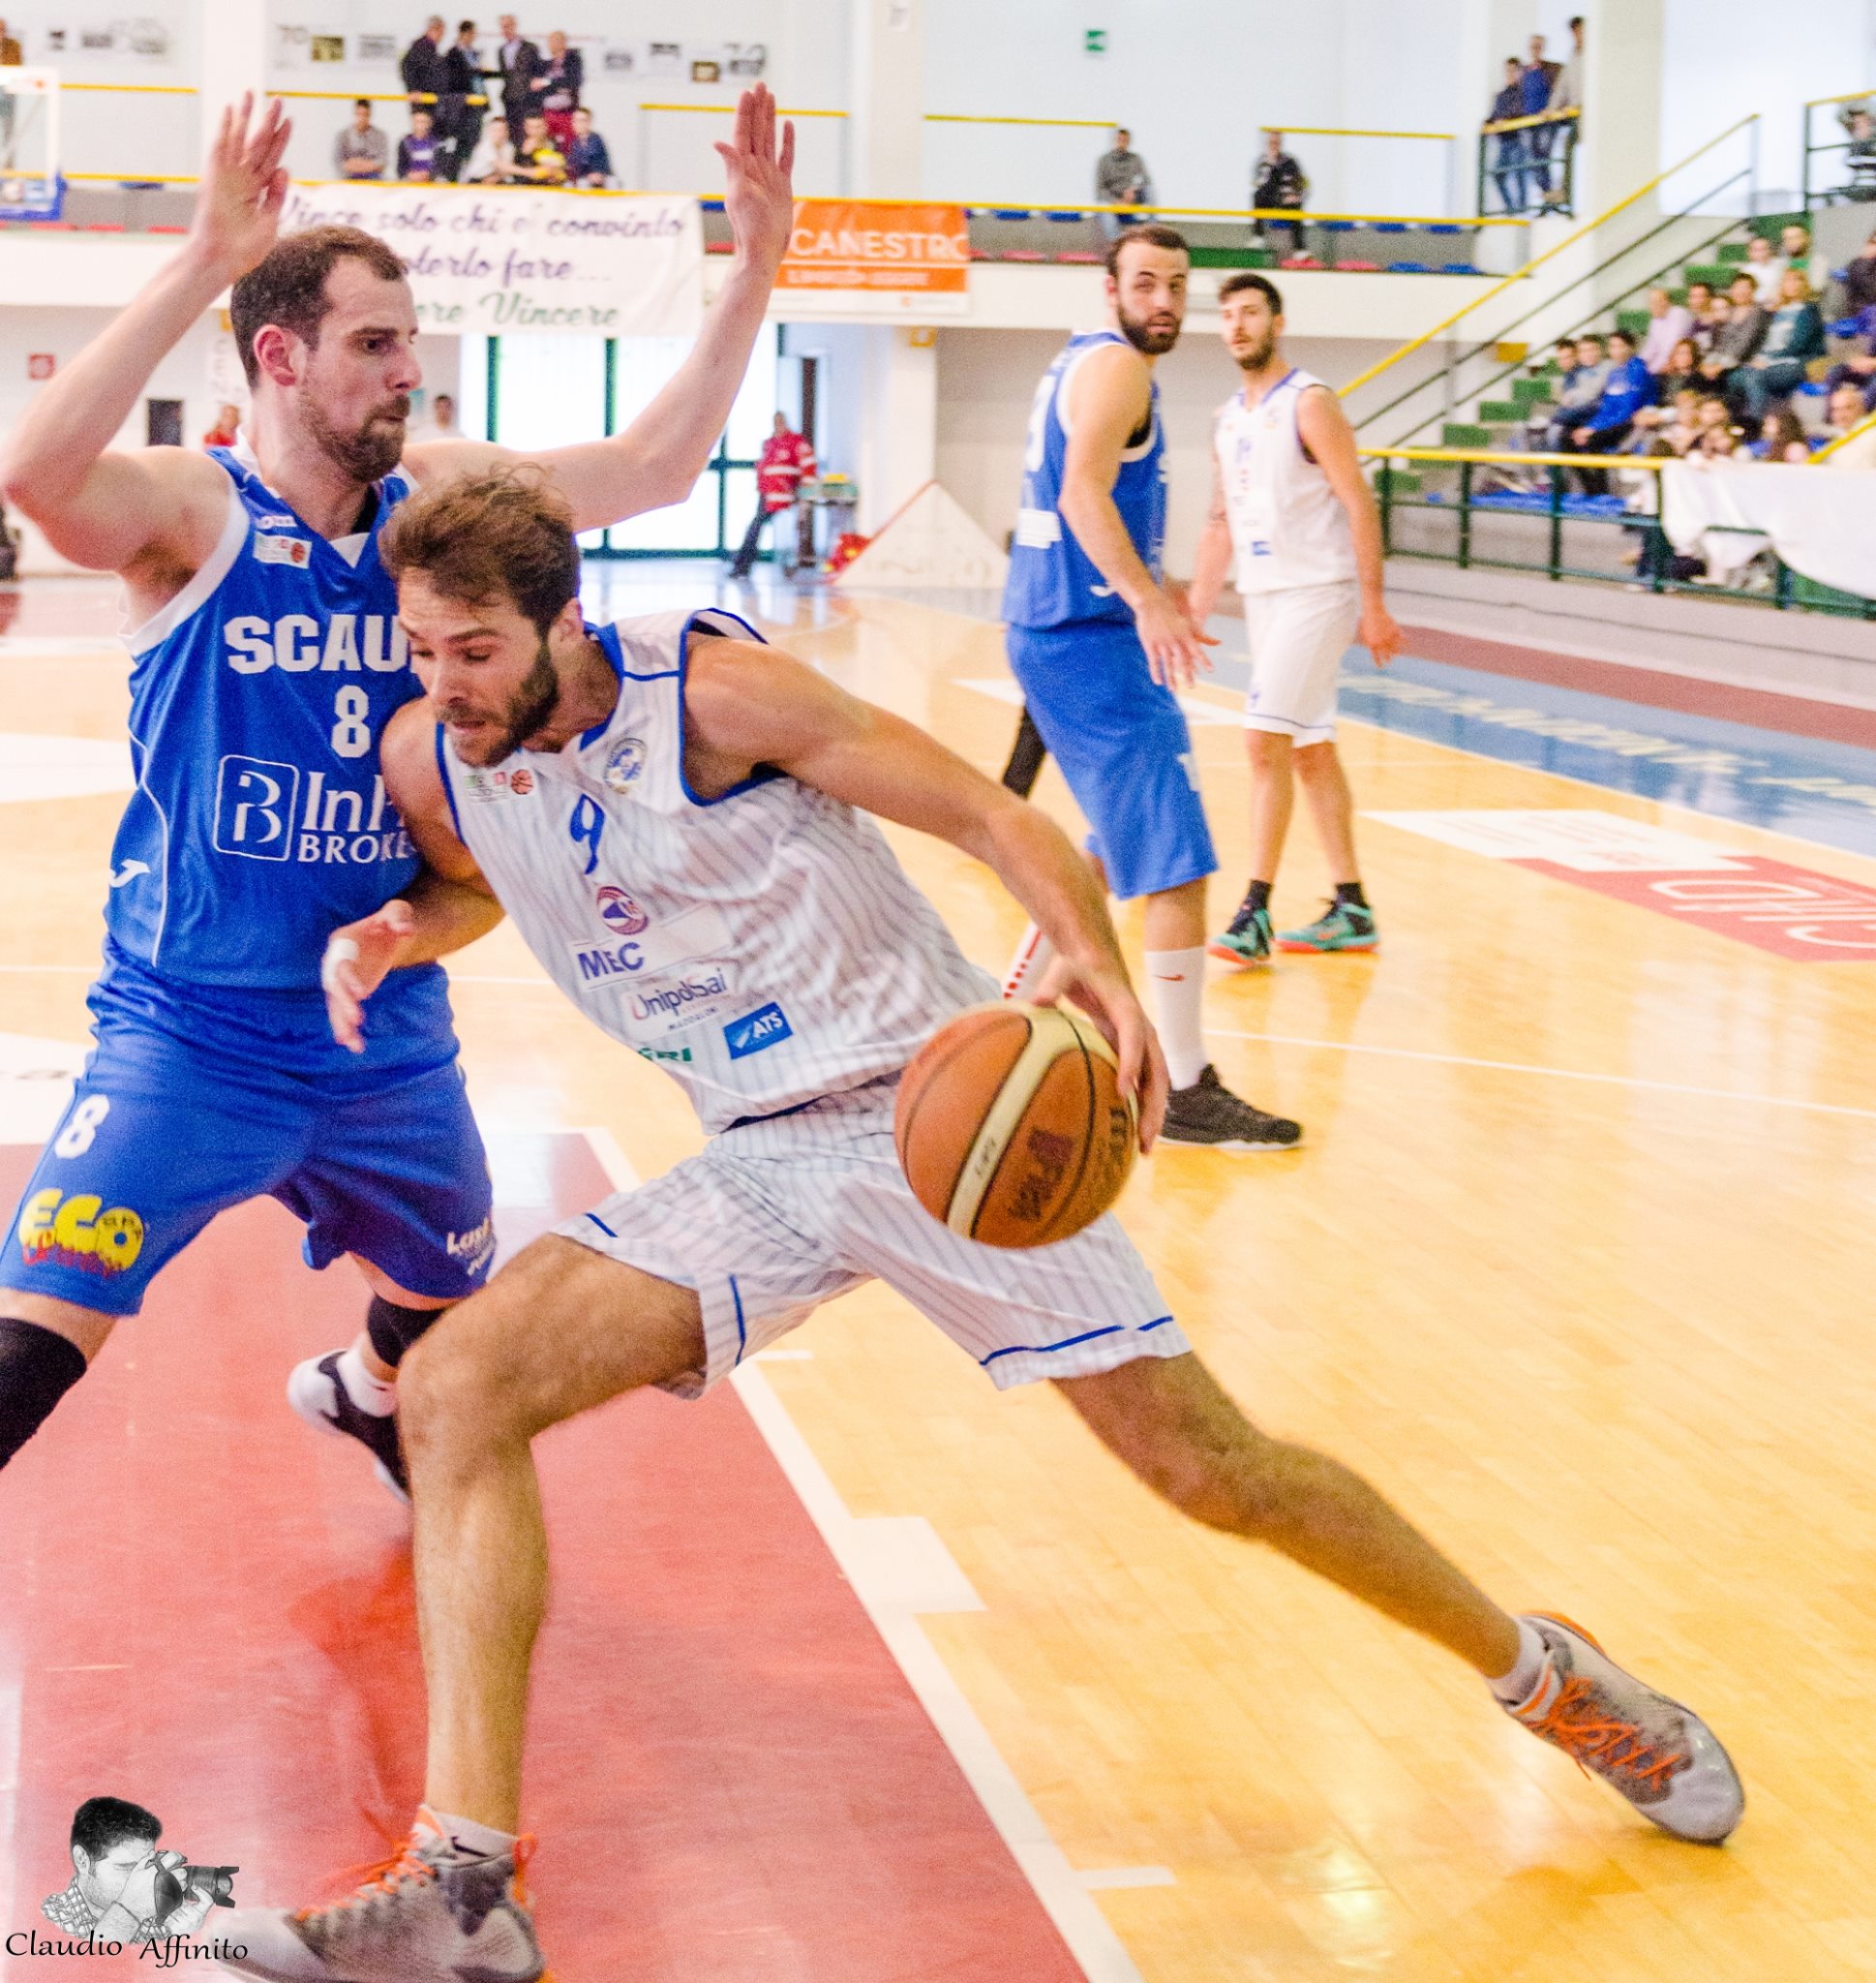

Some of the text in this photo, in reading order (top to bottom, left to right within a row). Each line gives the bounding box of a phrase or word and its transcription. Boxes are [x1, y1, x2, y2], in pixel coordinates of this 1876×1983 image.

[378, 202, 439, 231] solo
[450, 202, 502, 234] chi
[546, 207, 683, 237] convinto
[478, 291, 620, 327] Vincere
[224, 613, 408, 674] SCAU
[330, 685, 372, 758] 8
[297, 831, 417, 864] BROKE
[568, 793, 605, 874] 9
[751, 1011, 784, 1039] ATS
[55, 1093, 110, 1159] 8
[18, 1187, 144, 1271] ECO
